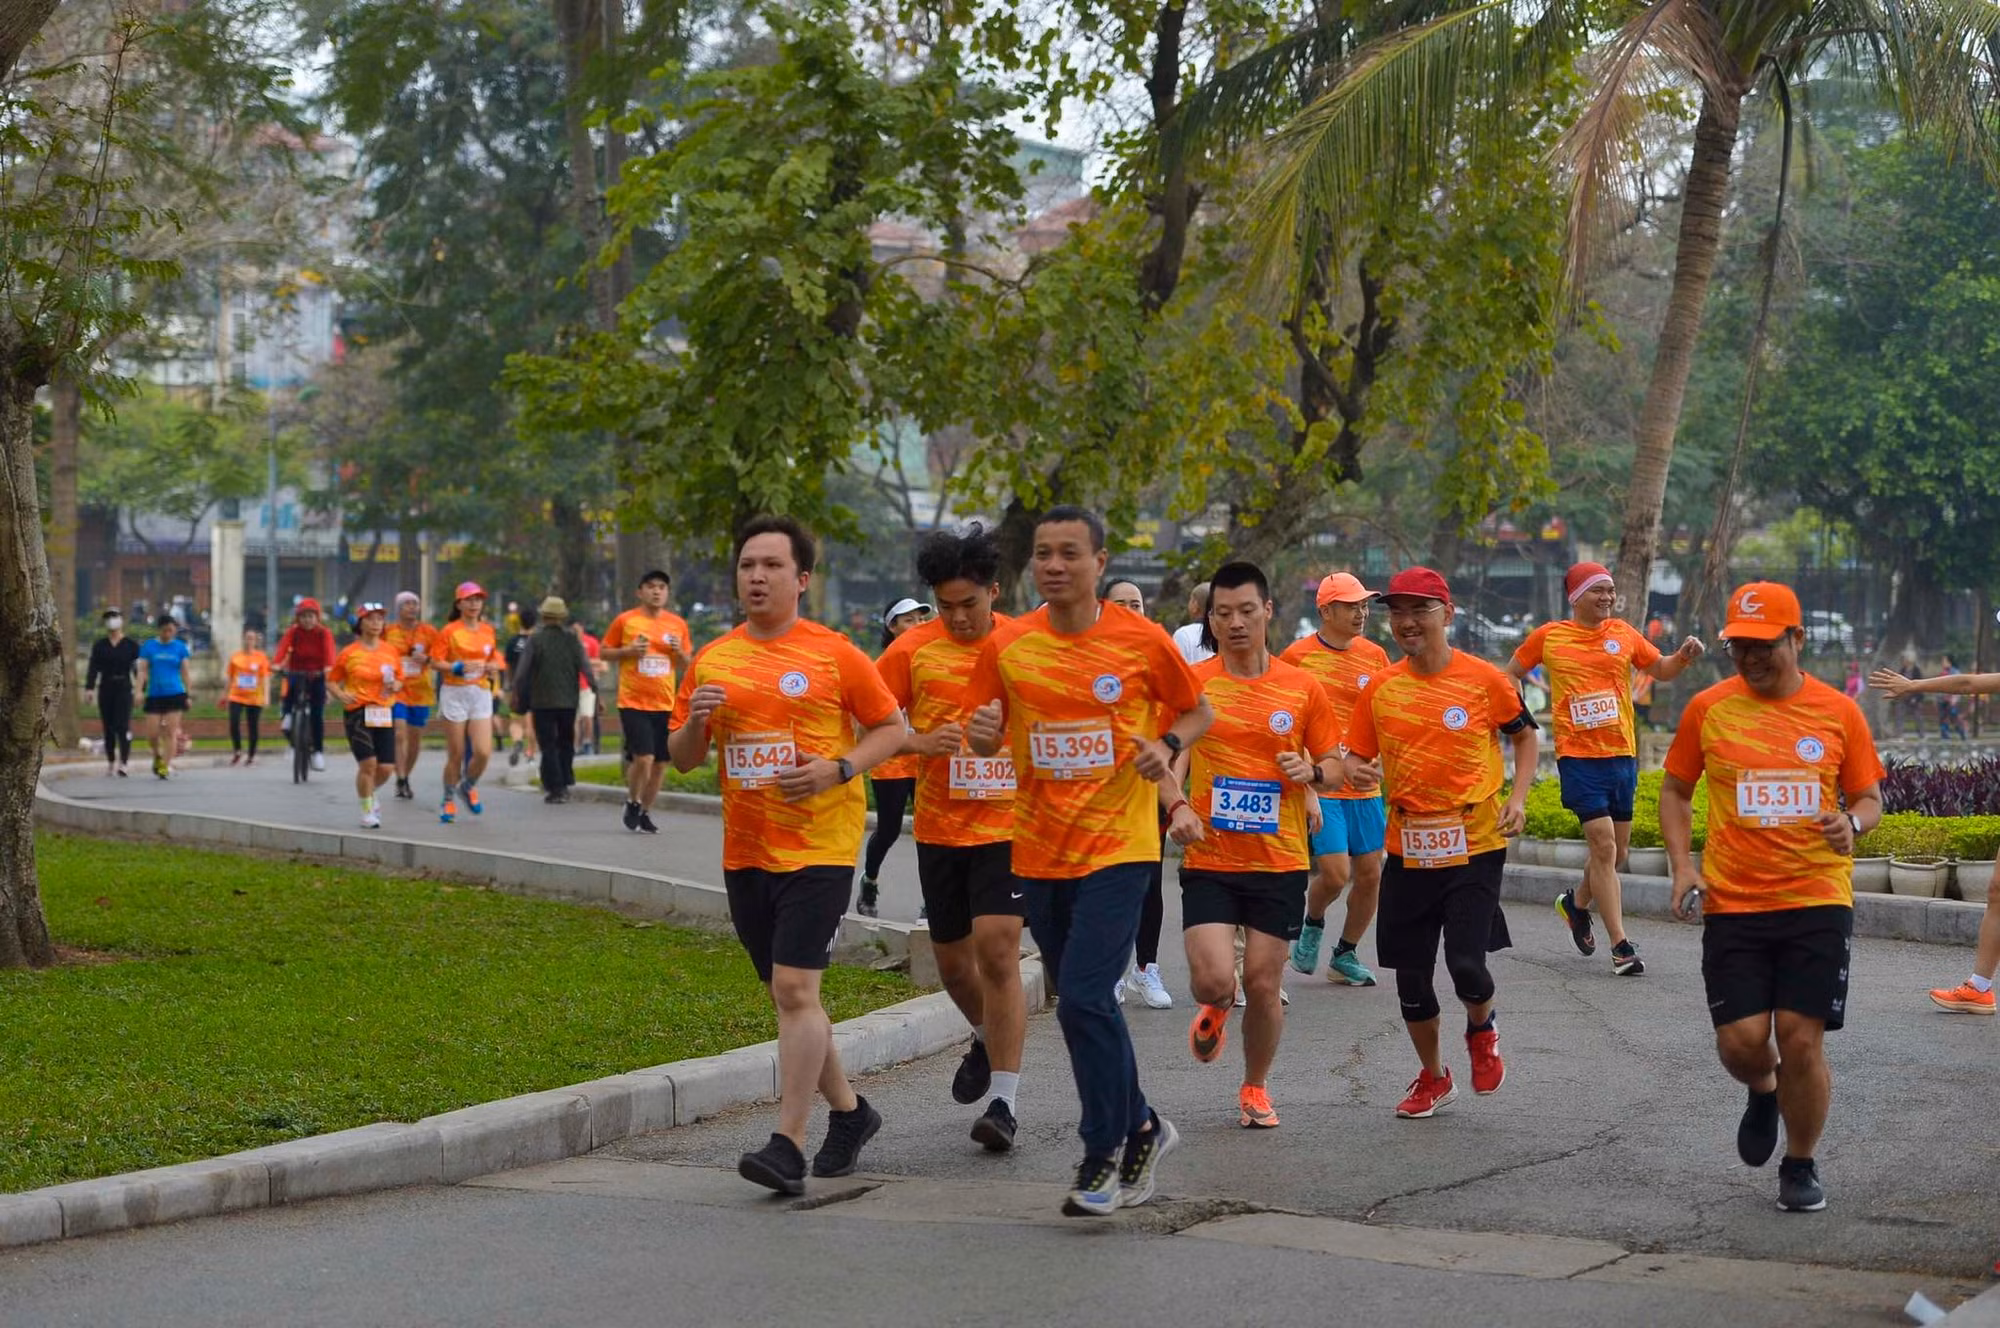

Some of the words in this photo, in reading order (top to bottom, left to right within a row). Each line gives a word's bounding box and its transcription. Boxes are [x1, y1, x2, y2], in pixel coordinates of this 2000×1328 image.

[1573, 699, 1615, 718] 15.304
[1033, 733, 1108, 758] 15.396
[728, 745, 794, 768] 15.642
[955, 760, 1015, 780] 15.302
[1220, 791, 1272, 813] 3.483
[1744, 785, 1812, 806] 15.311
[1403, 829, 1461, 850] 15.387
